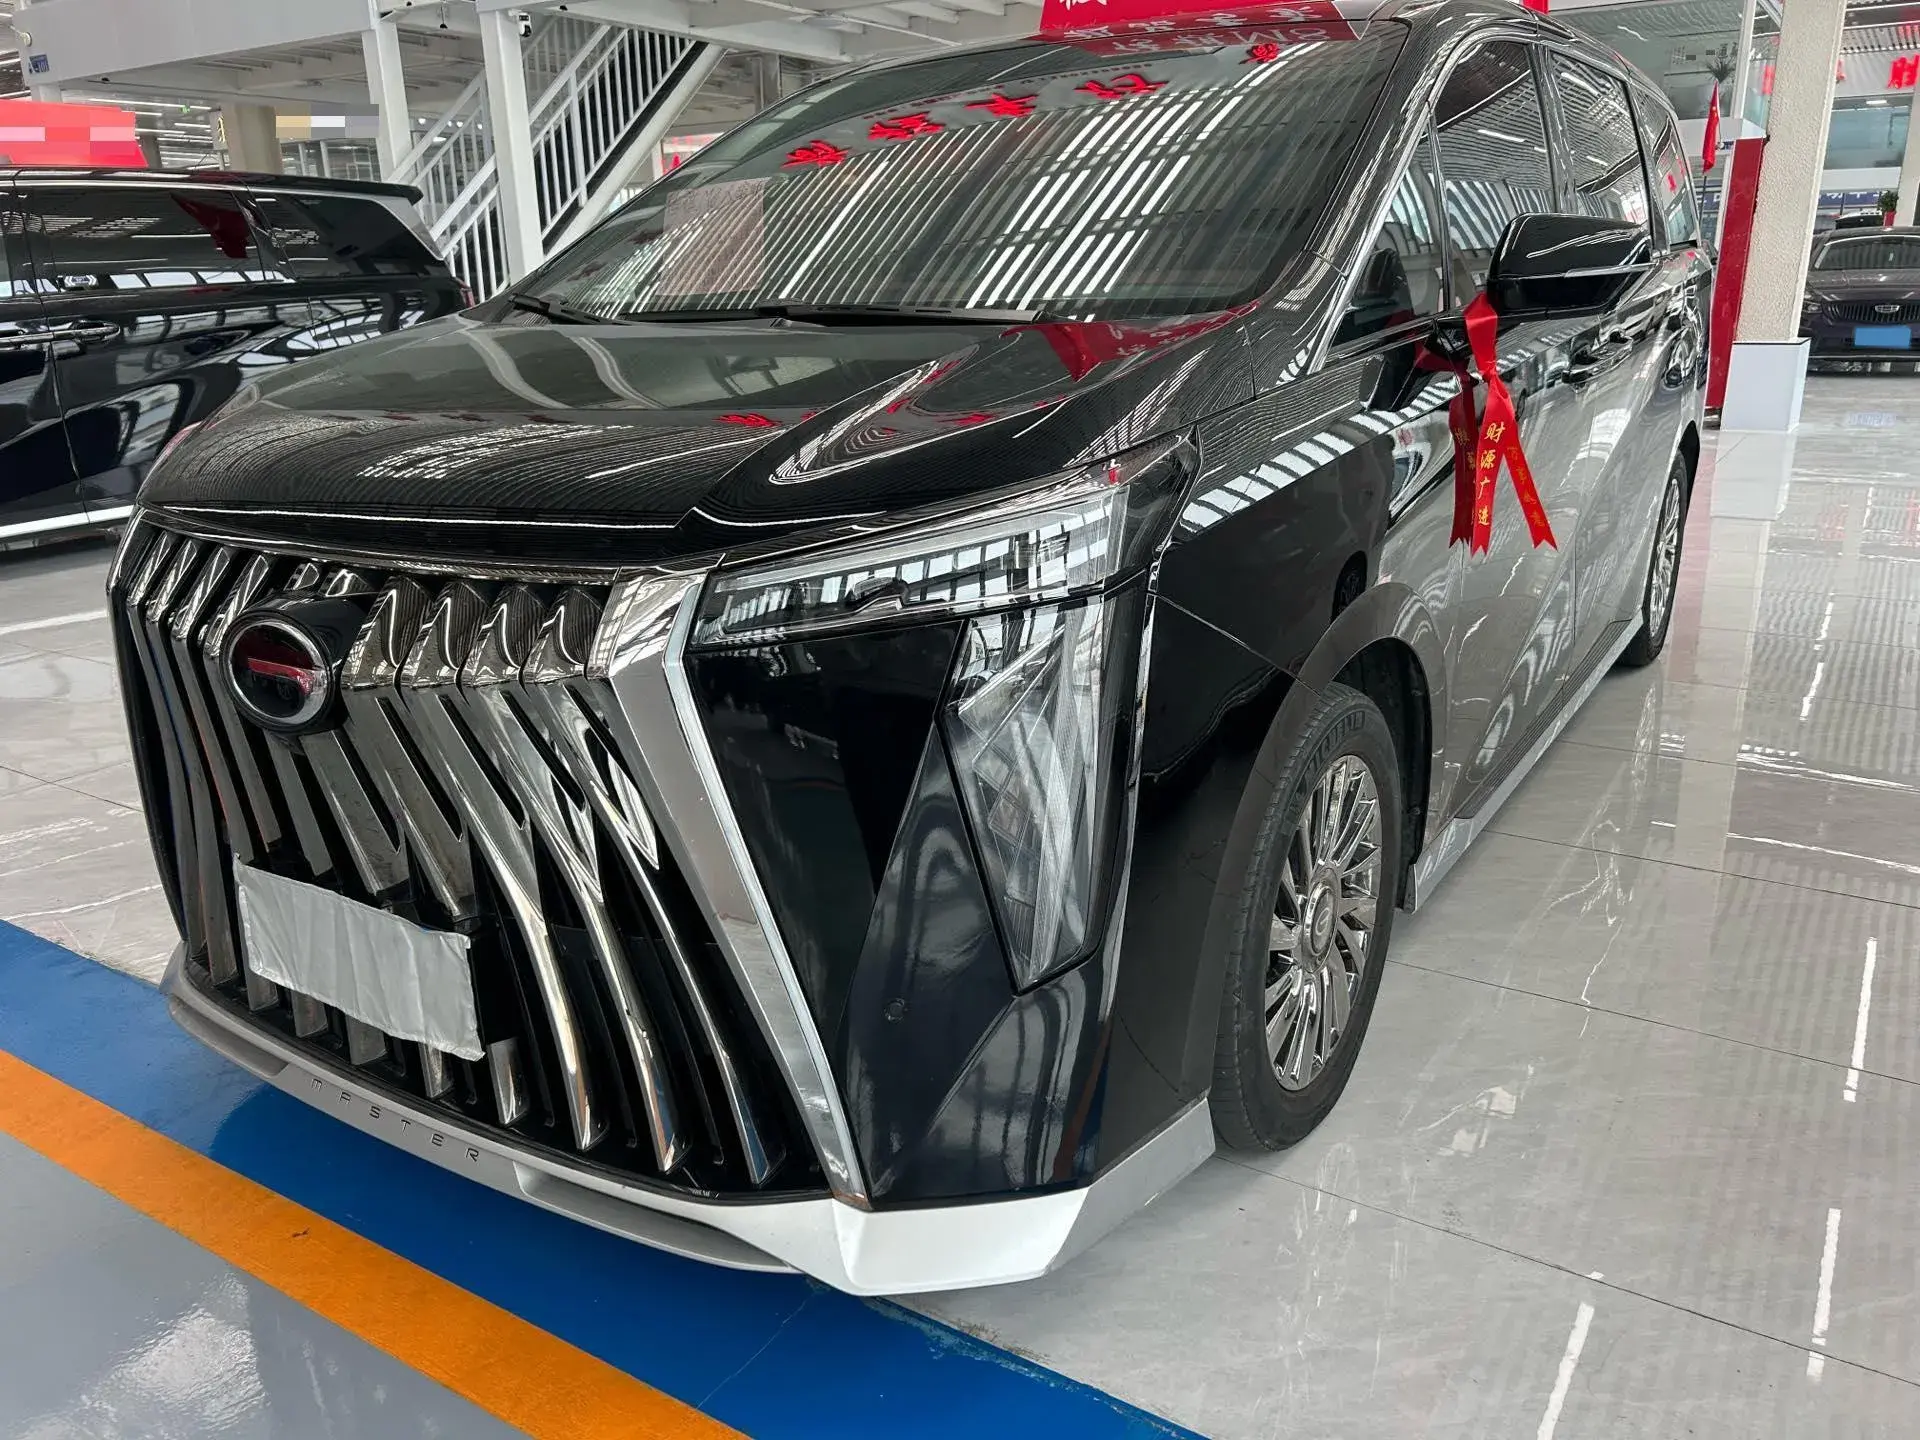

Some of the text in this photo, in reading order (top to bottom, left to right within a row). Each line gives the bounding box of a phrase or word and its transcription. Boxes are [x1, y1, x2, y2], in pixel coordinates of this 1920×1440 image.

[1478, 421, 1506, 526] 财源广进
[311, 1078, 479, 1162] MASTER
